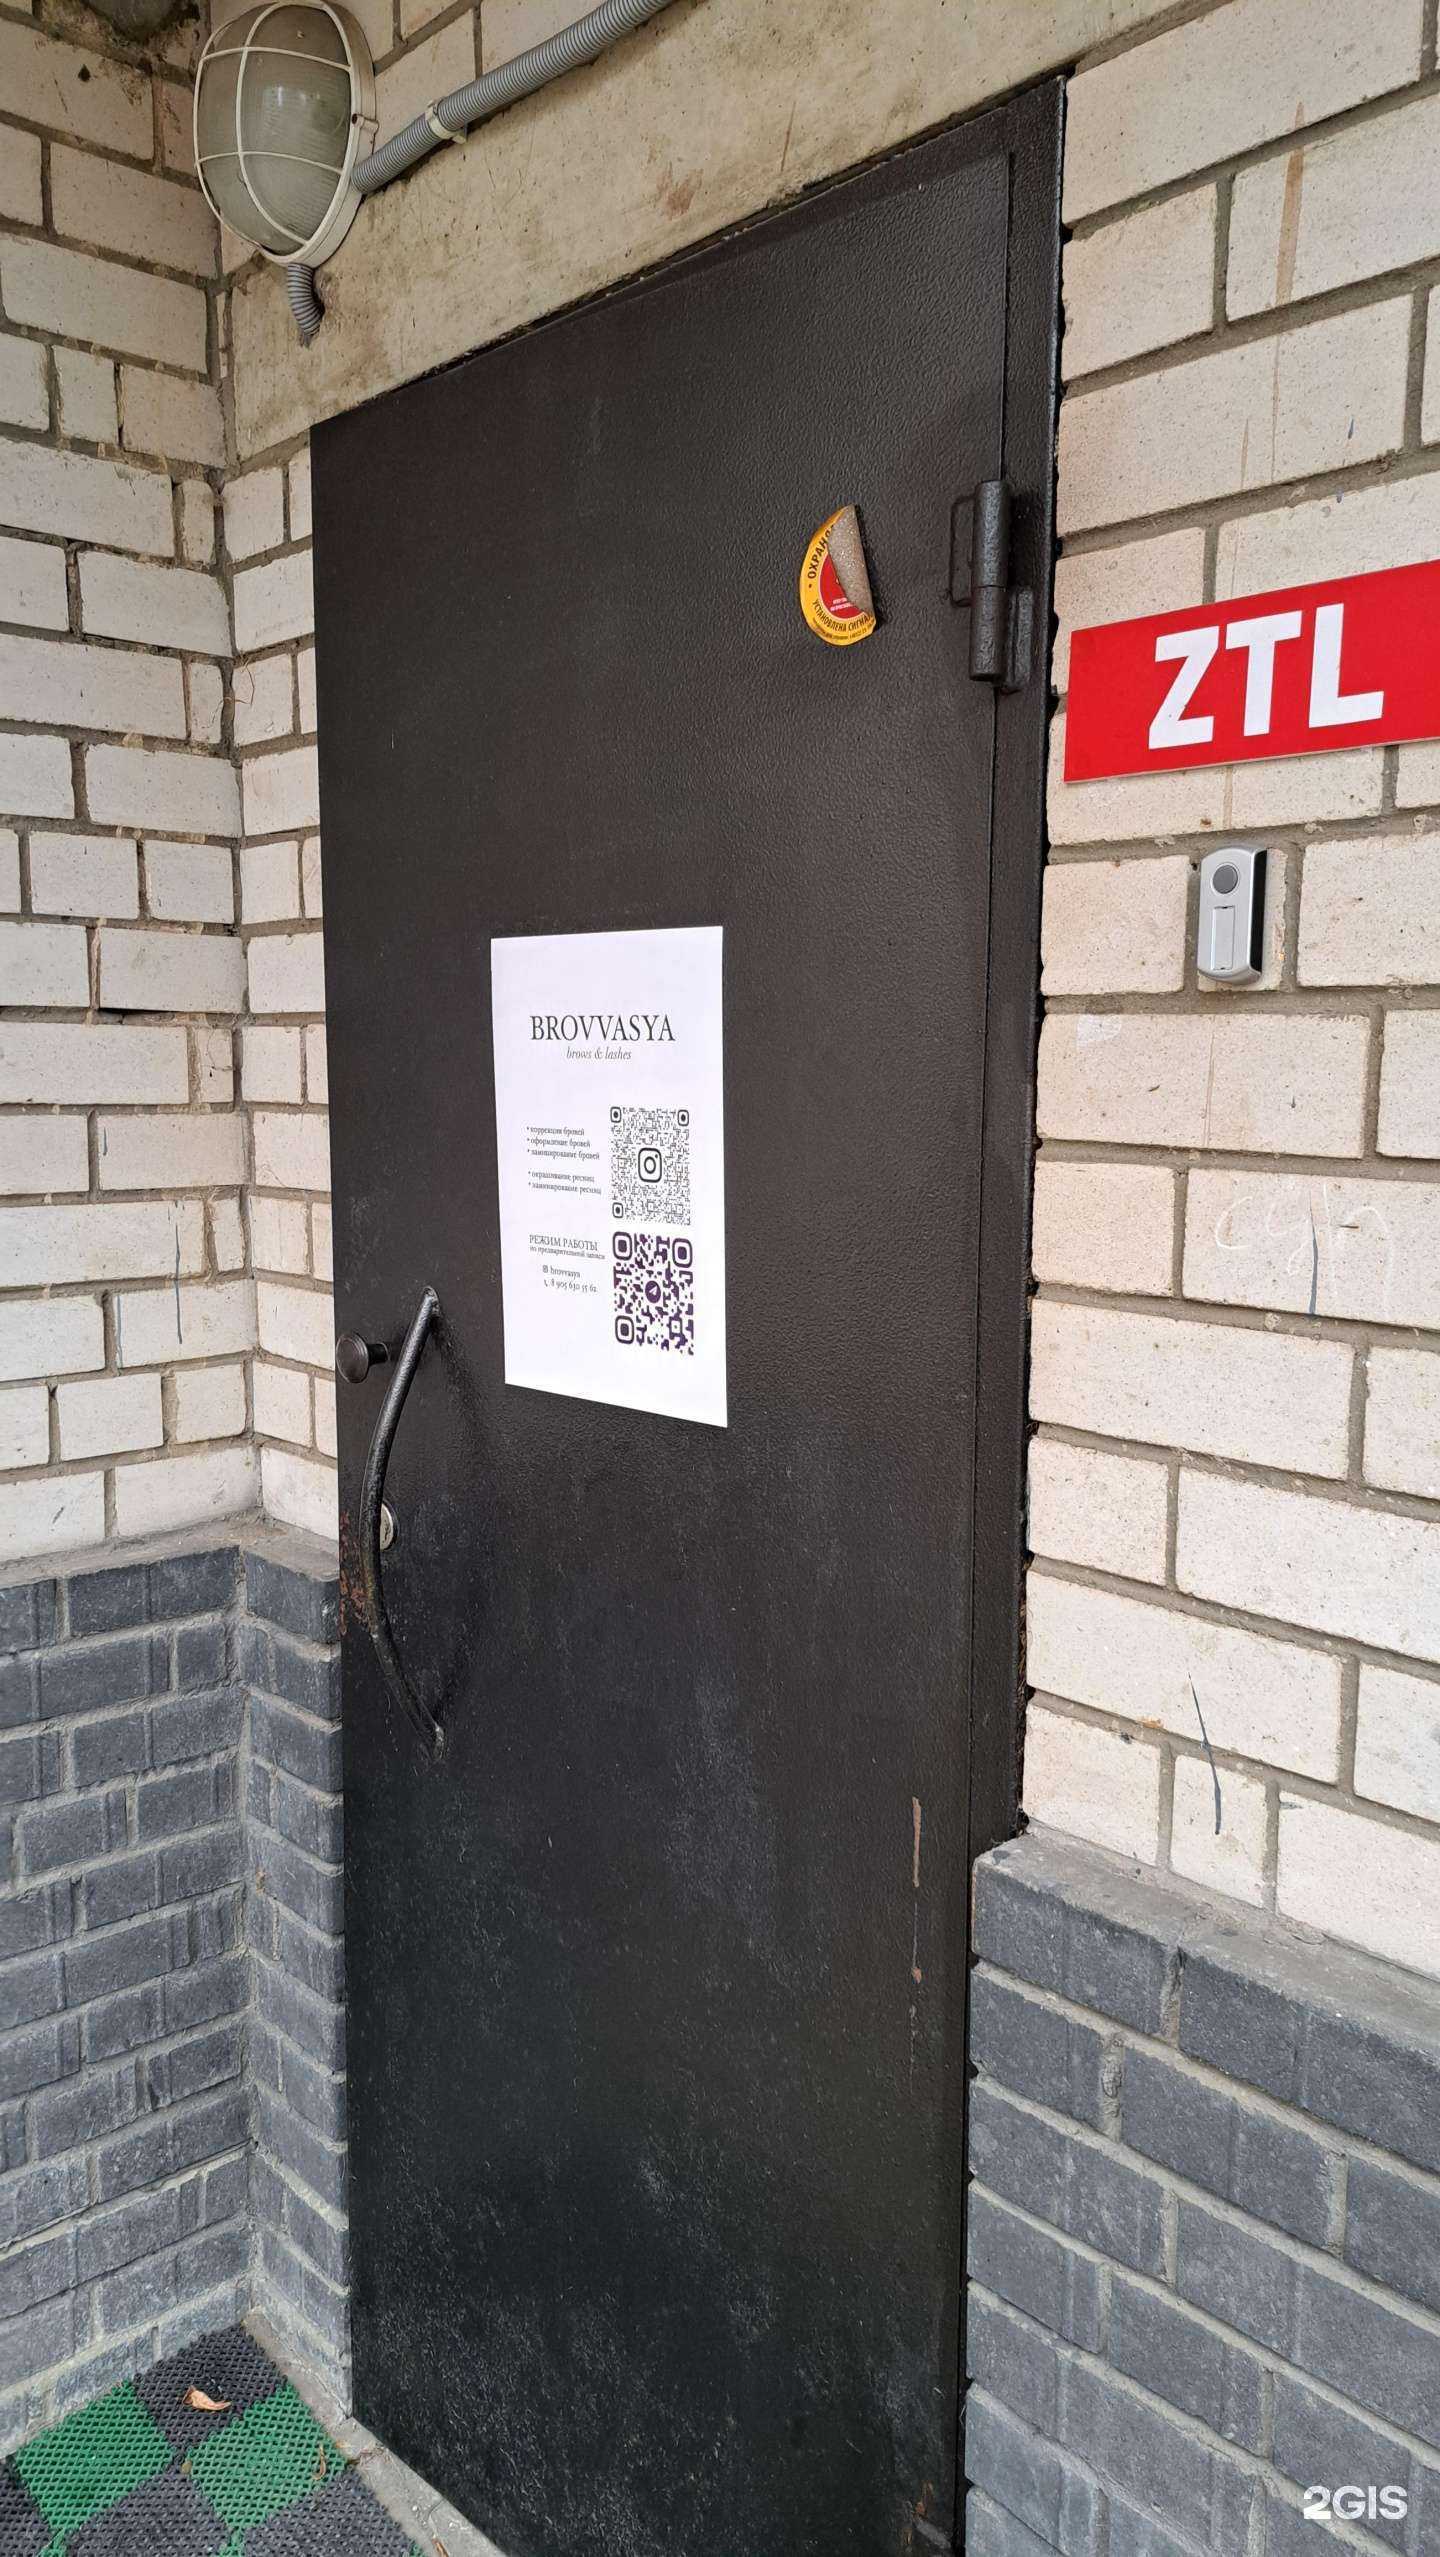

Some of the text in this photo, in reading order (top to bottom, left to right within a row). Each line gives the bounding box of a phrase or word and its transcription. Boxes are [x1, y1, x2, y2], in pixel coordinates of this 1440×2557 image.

[1148, 603, 1384, 750] ZTL
[530, 1014, 676, 1042] BROVVASYA
[566, 1046, 632, 1061] brows & lashes
[529, 1234, 598, 1251] РЕЖИМ РАБОТЫ
